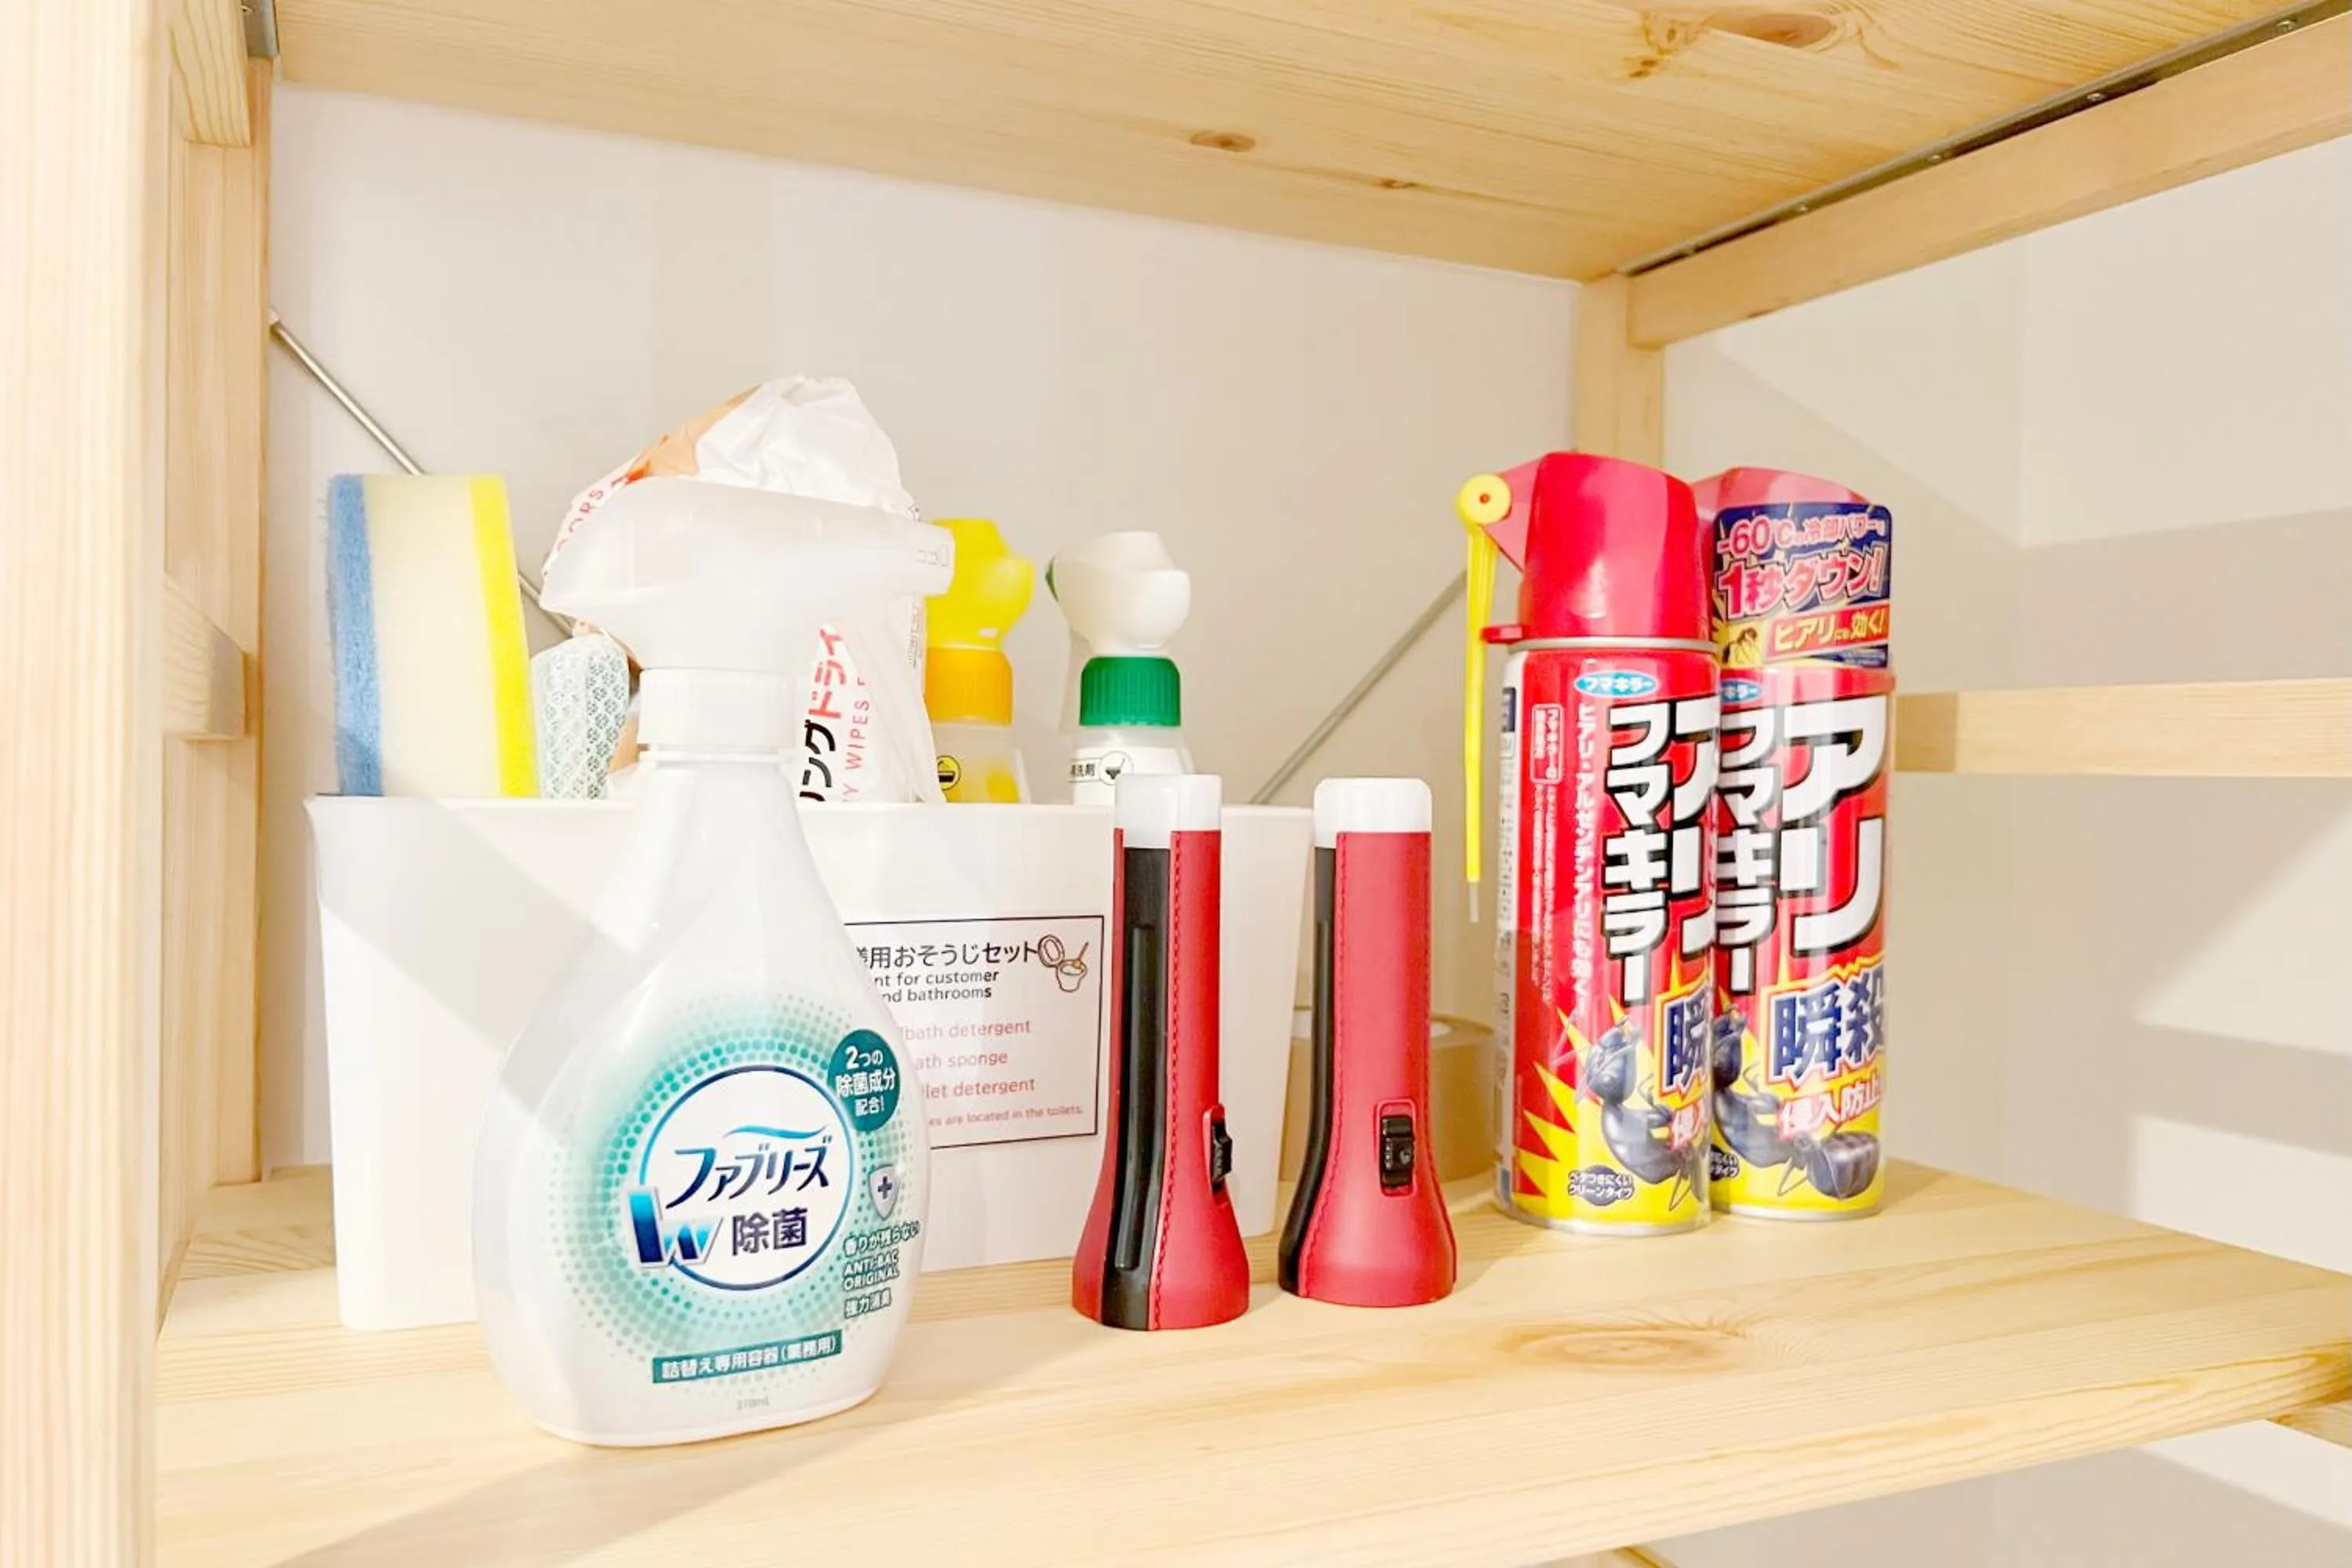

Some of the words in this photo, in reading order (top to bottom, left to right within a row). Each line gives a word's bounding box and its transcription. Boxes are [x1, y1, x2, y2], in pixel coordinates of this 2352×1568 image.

[1584, 676, 1654, 694] フマキラー
[845, 700, 870, 771] WIPES
[1780, 695, 1888, 954] アリ
[1605, 703, 1669, 1004] フマキラー
[874, 975, 890, 987] nt
[896, 973, 920, 986] for
[926, 971, 1000, 985] customer
[881, 989, 902, 1003] nd
[907, 986, 993, 1002] bathrooms
[949, 1020, 1032, 1039] detergent
[844, 1046, 884, 1069] 2つの
[914, 1055, 942, 1069] ath
[947, 1052, 1008, 1069] sponge
[835, 1069, 896, 1098] 除菌成分
[953, 1078, 1036, 1098] detergent
[855, 1096, 885, 1116] 配合!
[946, 1116, 964, 1125] are
[966, 1110, 1009, 1123] located
[1012, 1109, 1023, 1119] in
[1025, 1107, 1044, 1118] the
[665, 1135, 833, 1209] ファブリーズ
[844, 1266, 900, 1291] ORIGINAL
